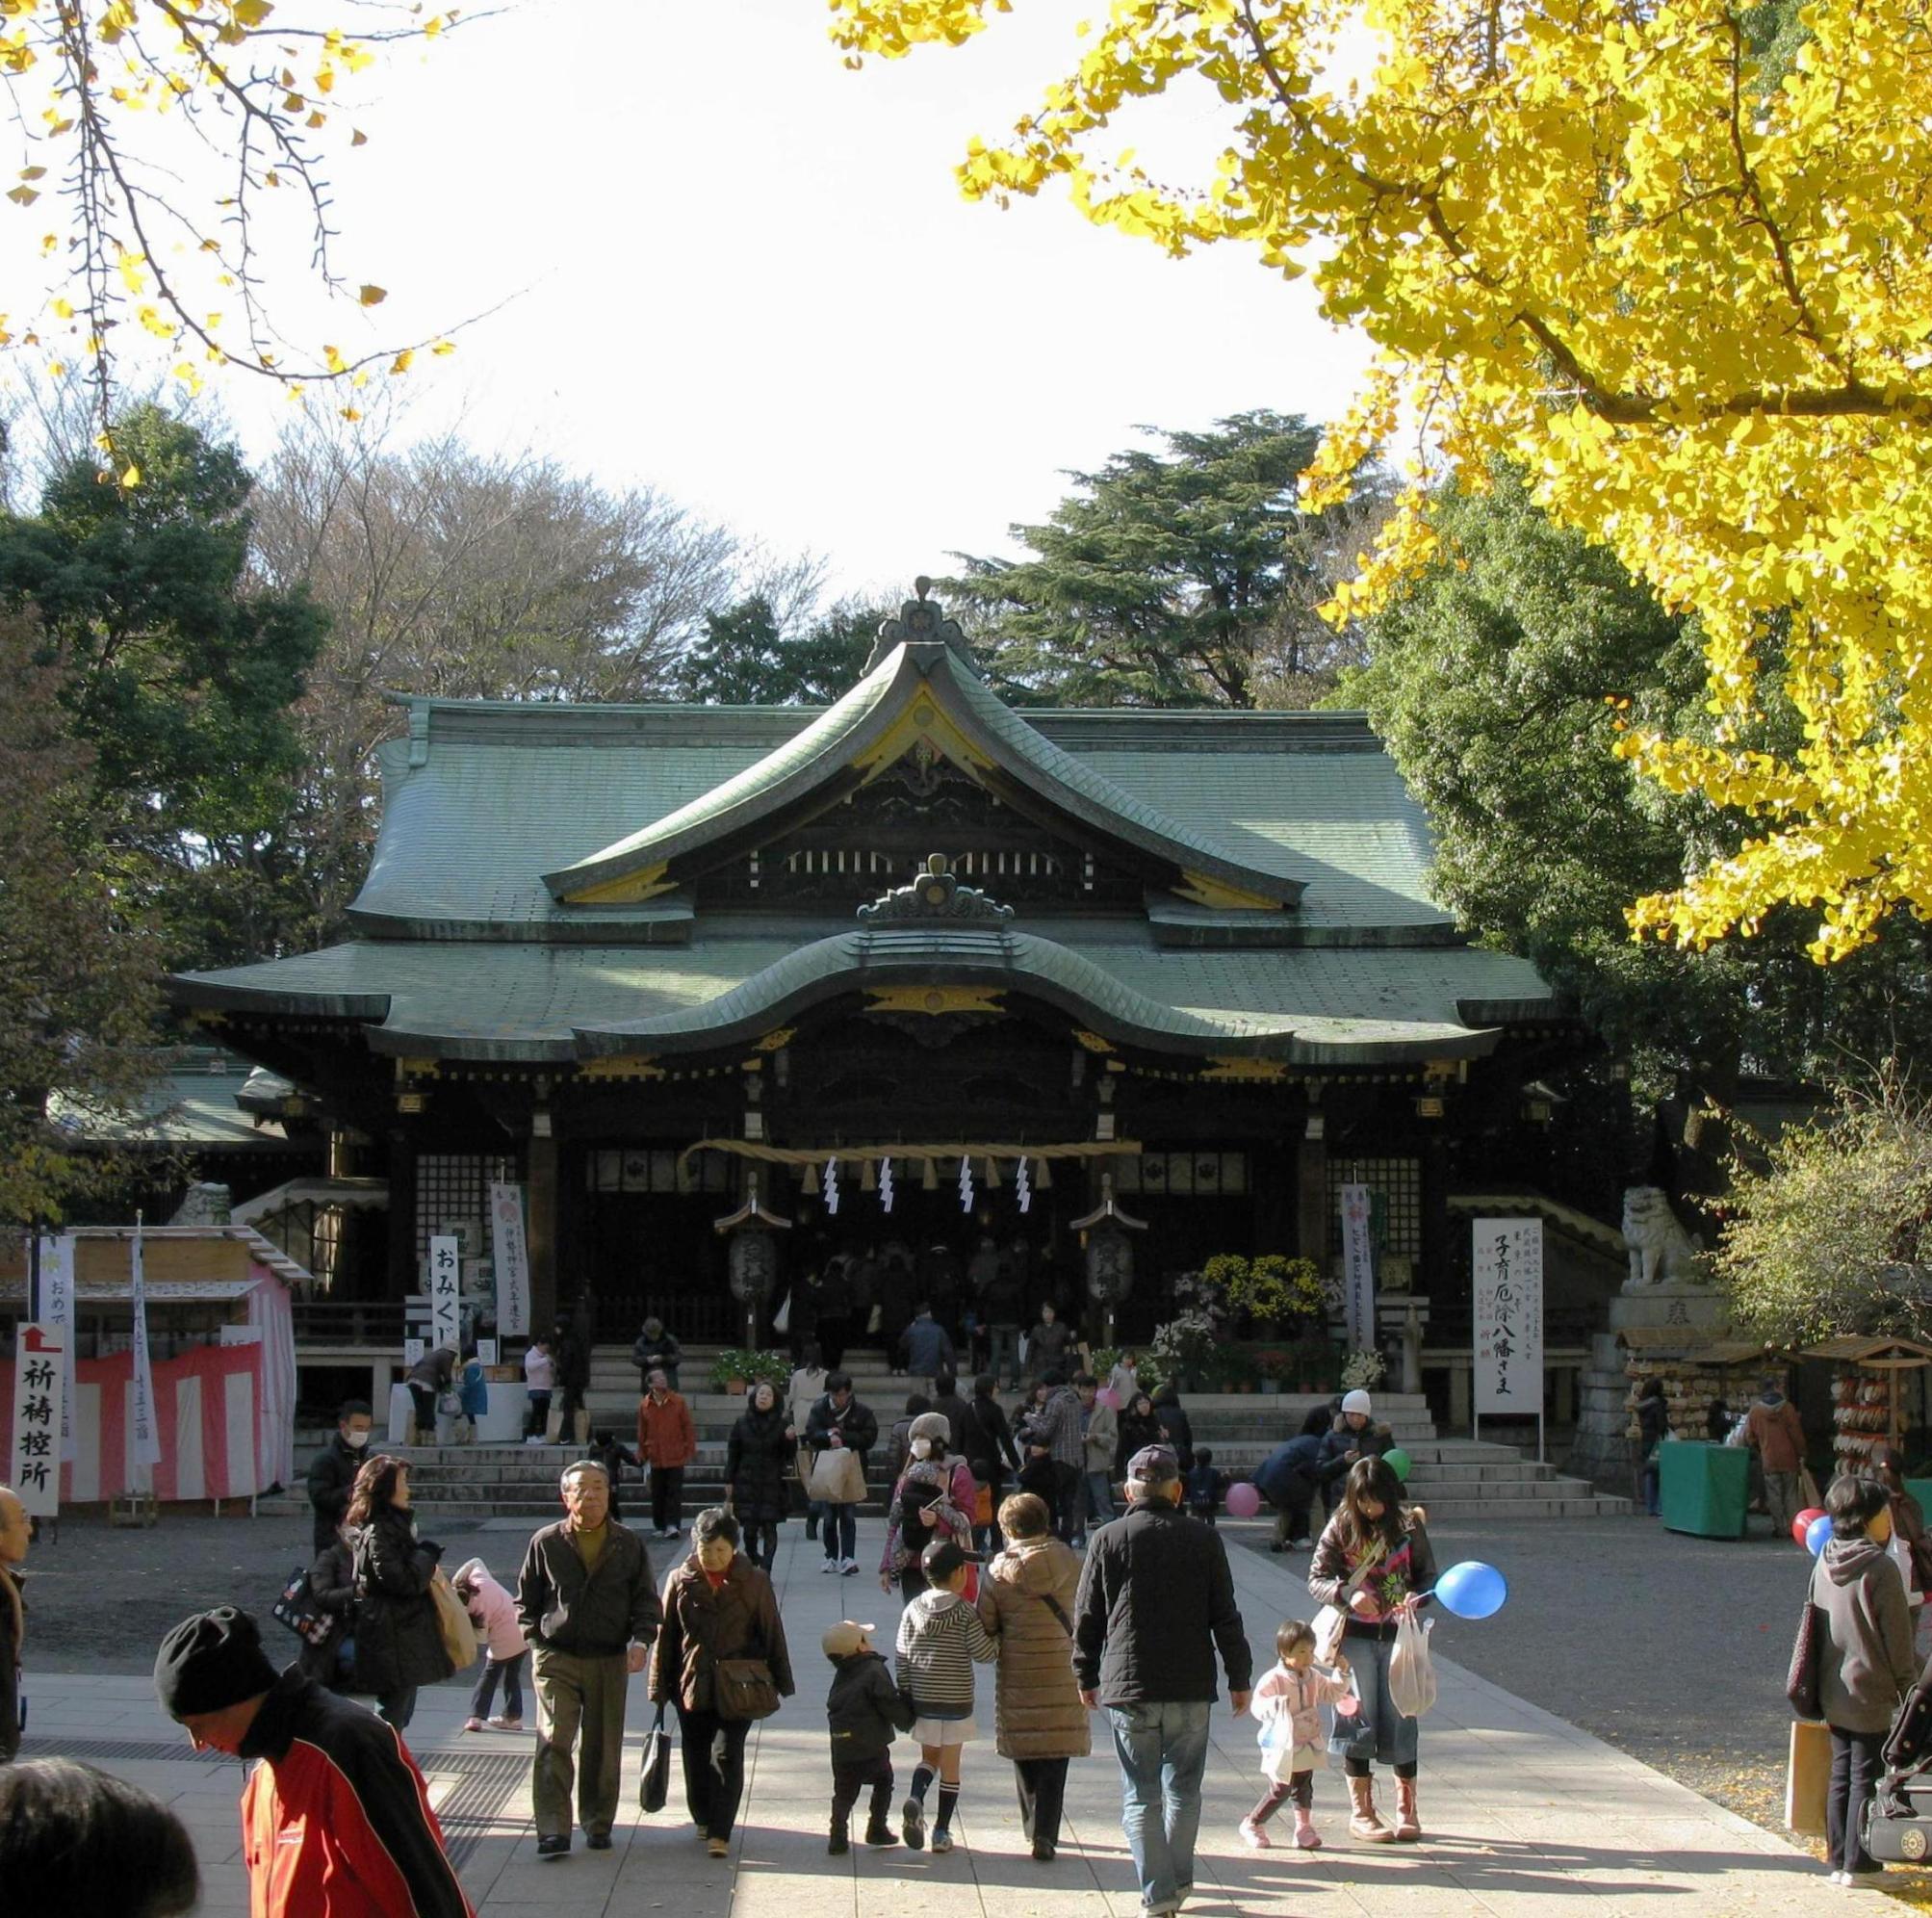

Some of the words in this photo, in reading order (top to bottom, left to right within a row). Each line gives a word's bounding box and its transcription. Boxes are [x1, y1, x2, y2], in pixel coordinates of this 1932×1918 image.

[436, 1249, 456, 1345] おみくじ
[1493, 1233, 1516, 1395] 子育厄除八幡さま
[19, 1360, 56, 1493] 祈祷控所
